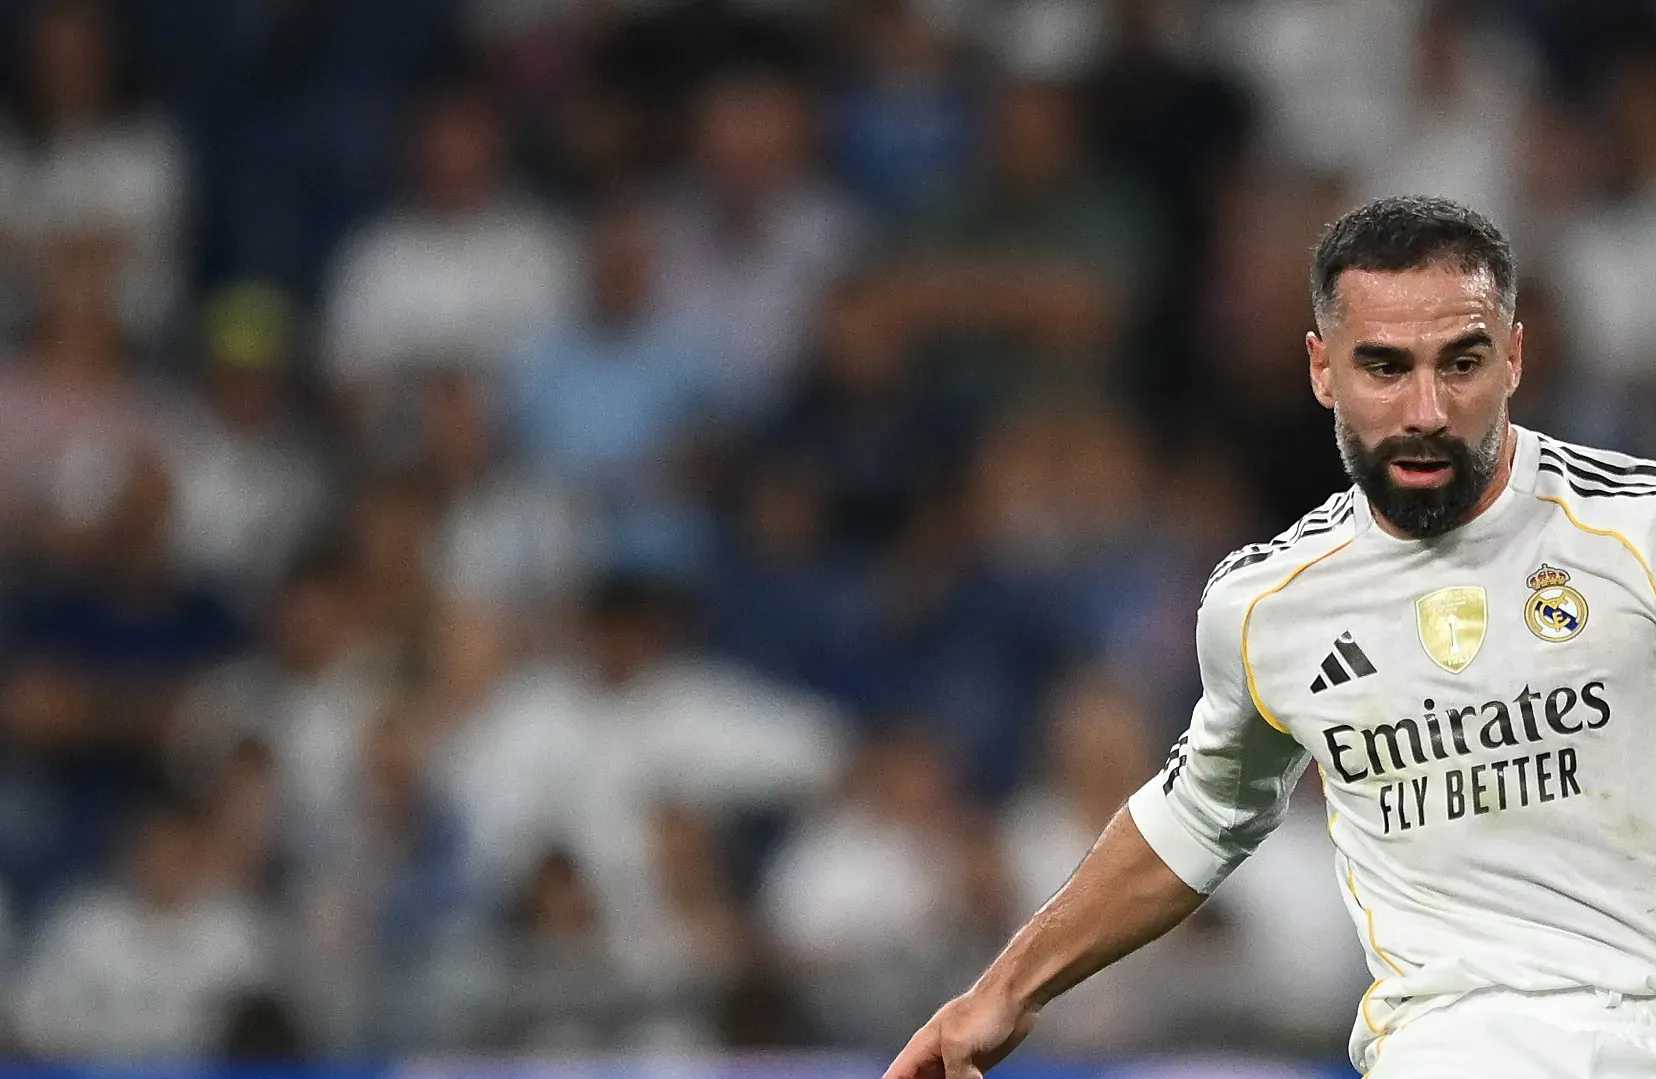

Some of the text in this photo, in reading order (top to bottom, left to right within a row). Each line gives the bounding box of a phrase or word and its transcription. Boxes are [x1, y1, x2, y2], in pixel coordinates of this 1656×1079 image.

[1322, 681, 1611, 784] Emirates
[1379, 747, 1582, 834] FLY BETTER
